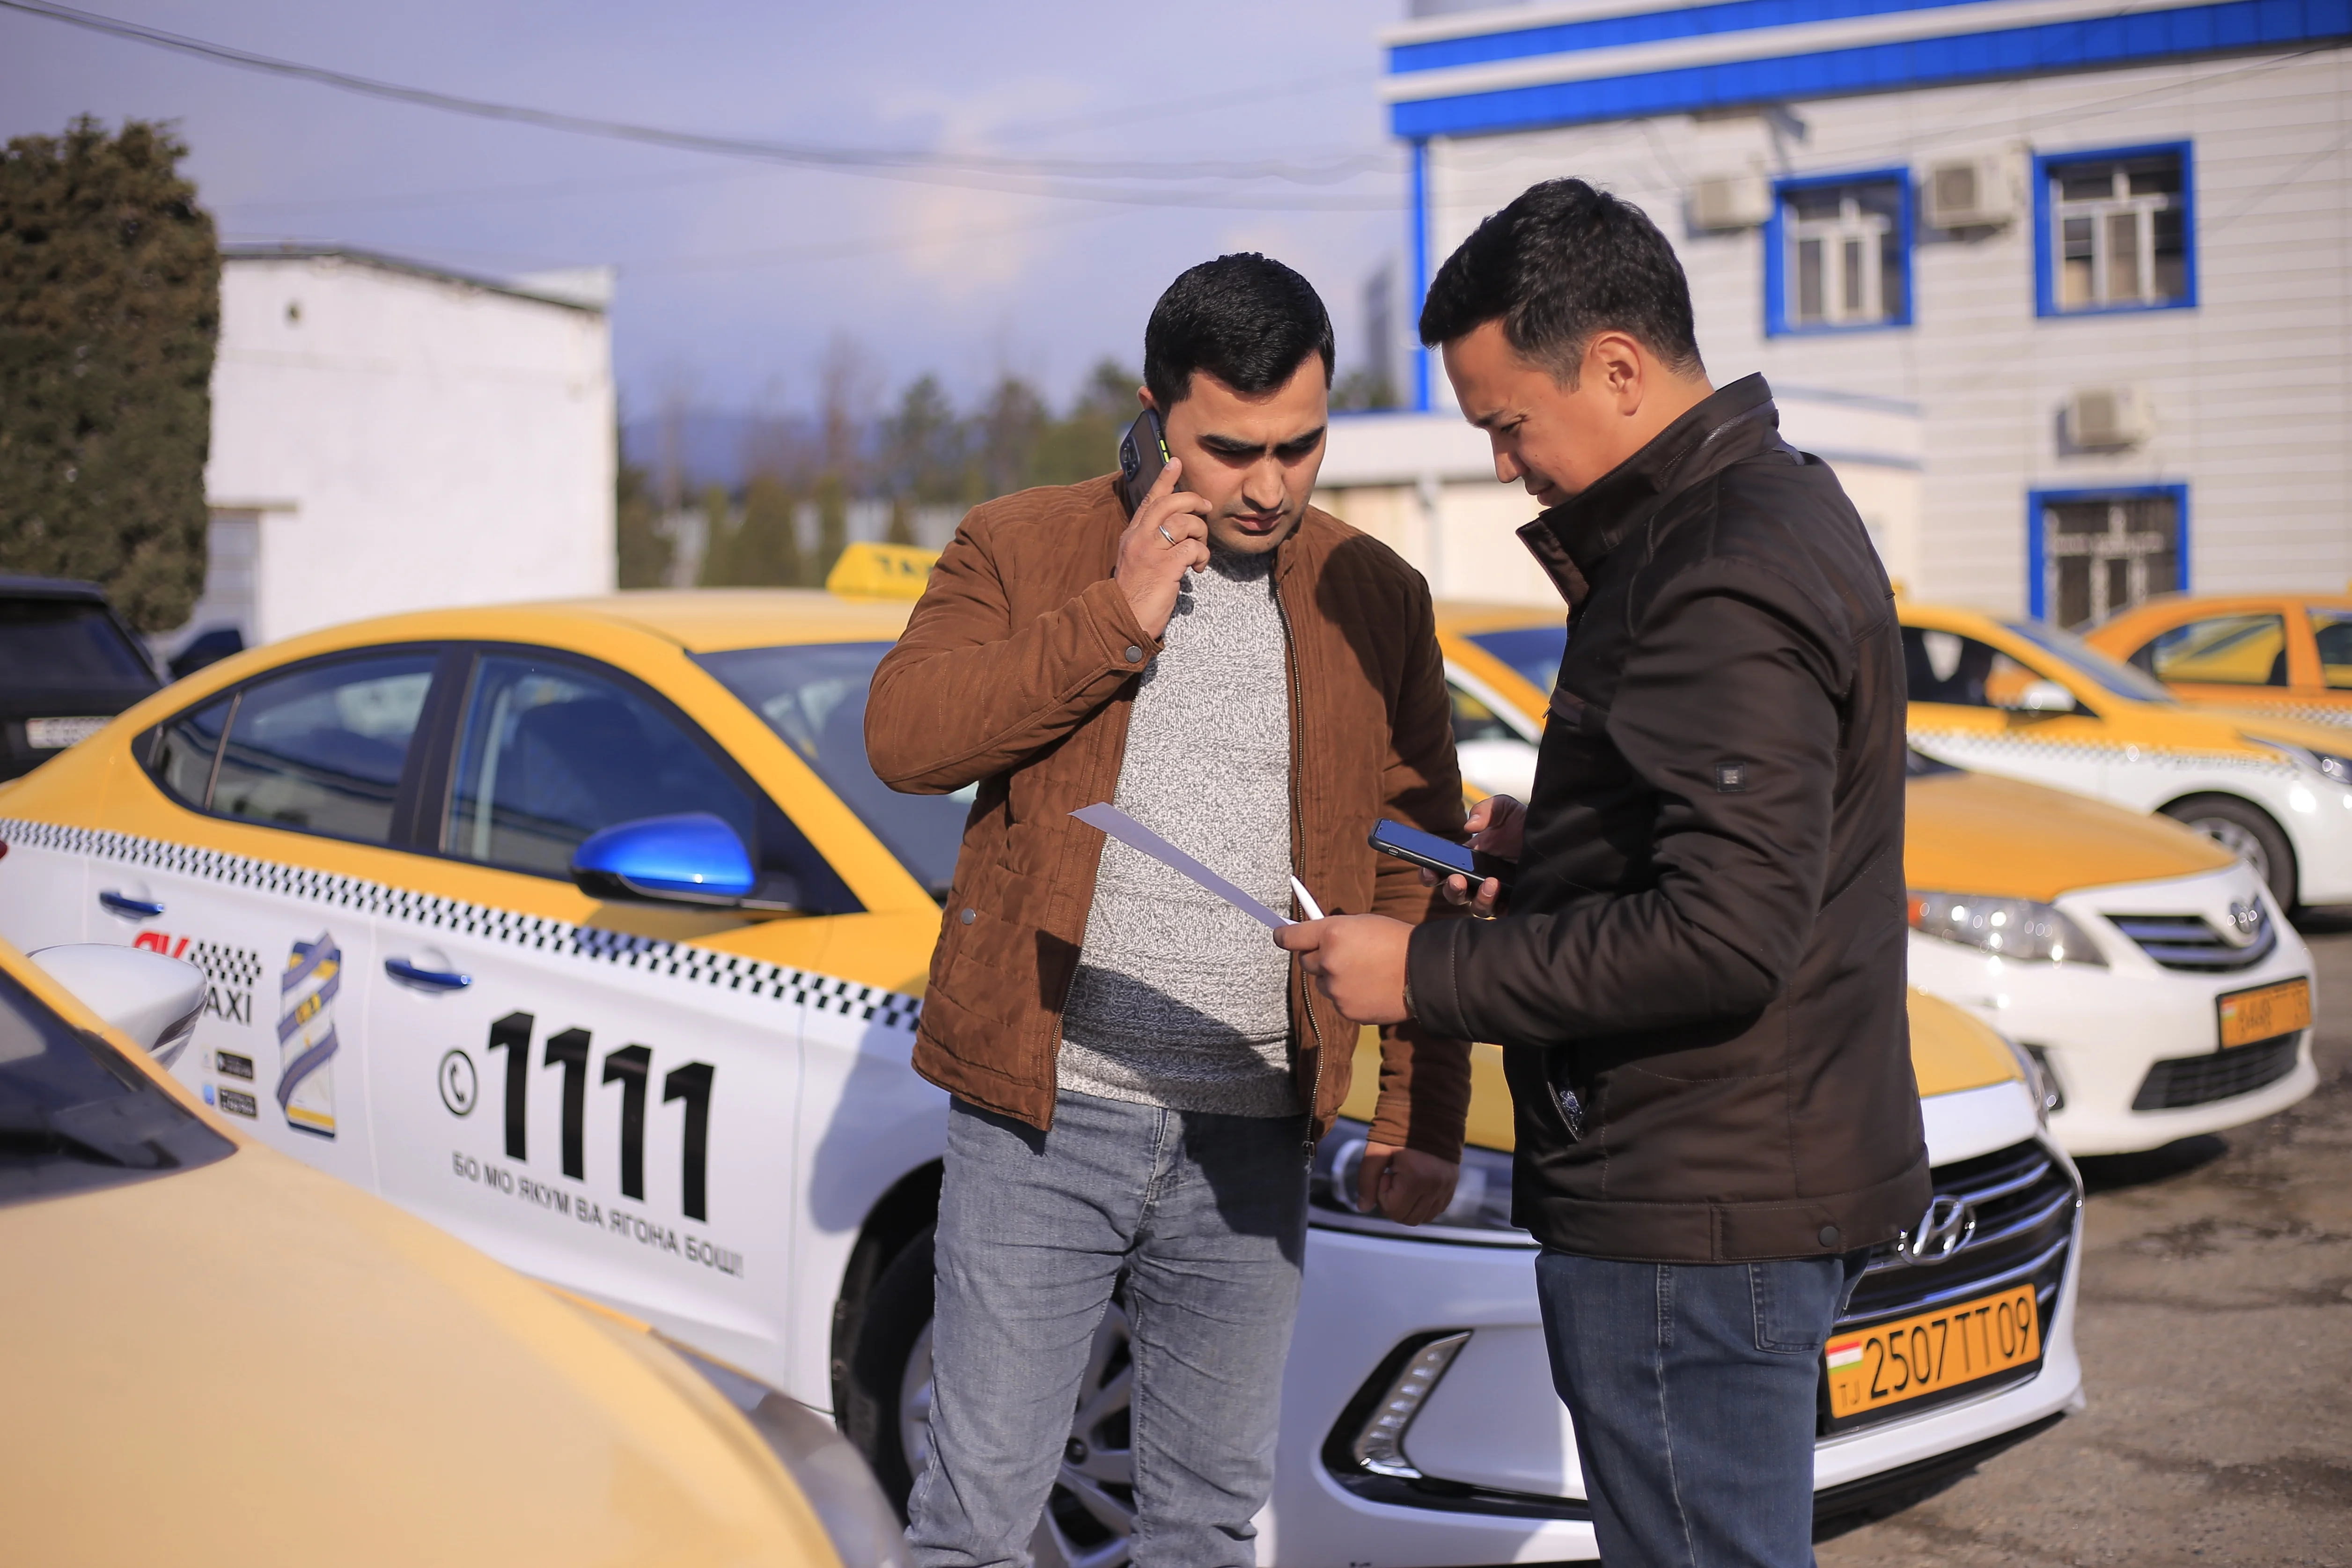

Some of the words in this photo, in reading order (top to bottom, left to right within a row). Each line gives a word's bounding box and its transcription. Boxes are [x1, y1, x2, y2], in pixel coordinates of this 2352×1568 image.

[204, 986, 251, 1023] AXI
[488, 1011, 715, 1223] 1111
[452, 1151, 479, 1181] БО
[484, 1164, 514, 1194] МО
[518, 1177, 571, 1215] ЯКУМ
[575, 1197, 605, 1229] ВА
[610, 1208, 680, 1255] ЯГОНА
[1839, 1380, 1860, 1408] TJ
